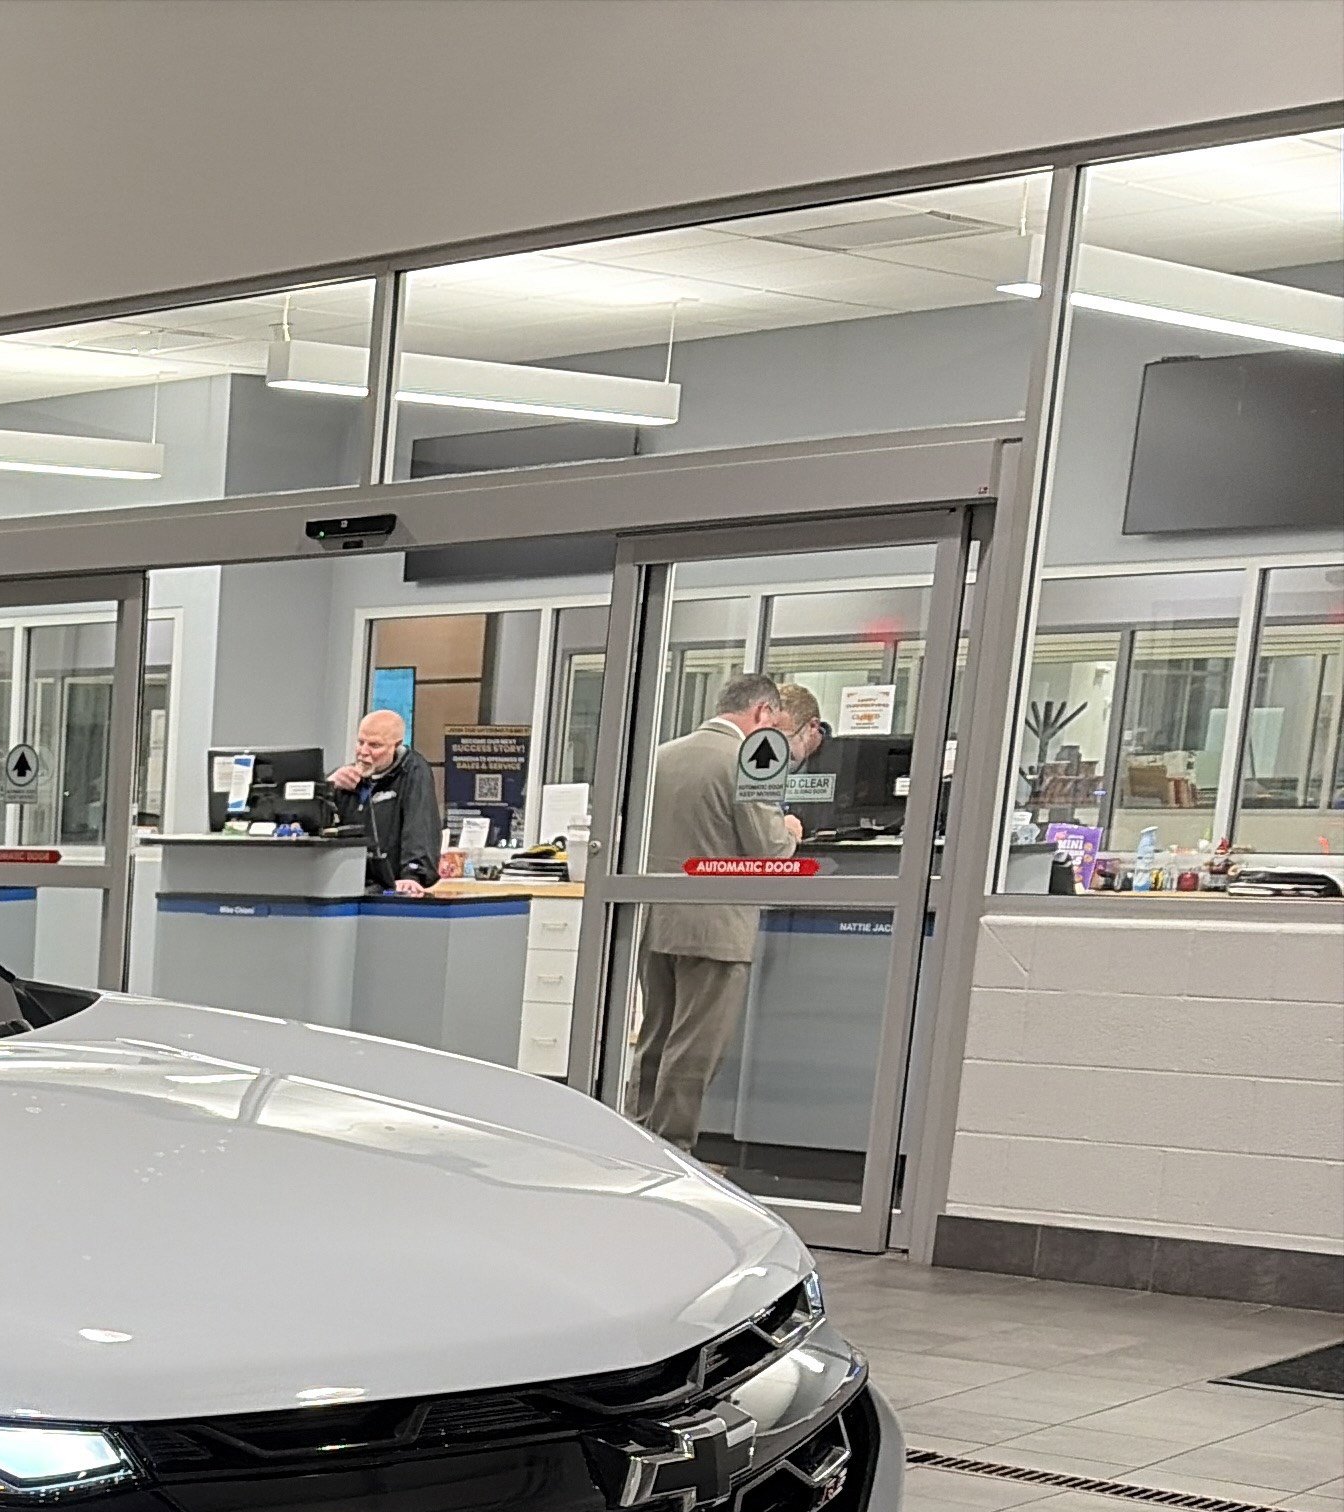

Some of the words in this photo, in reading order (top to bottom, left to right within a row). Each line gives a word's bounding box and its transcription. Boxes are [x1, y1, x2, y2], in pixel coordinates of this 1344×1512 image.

[452, 744, 492, 753] SUCCESS
[798, 779, 830, 788] CLEAR
[696, 861, 763, 873] AUTOMATIC
[764, 861, 801, 873] DOOR
[839, 923, 872, 932] NATTIE
[872, 923, 893, 932] JAC
